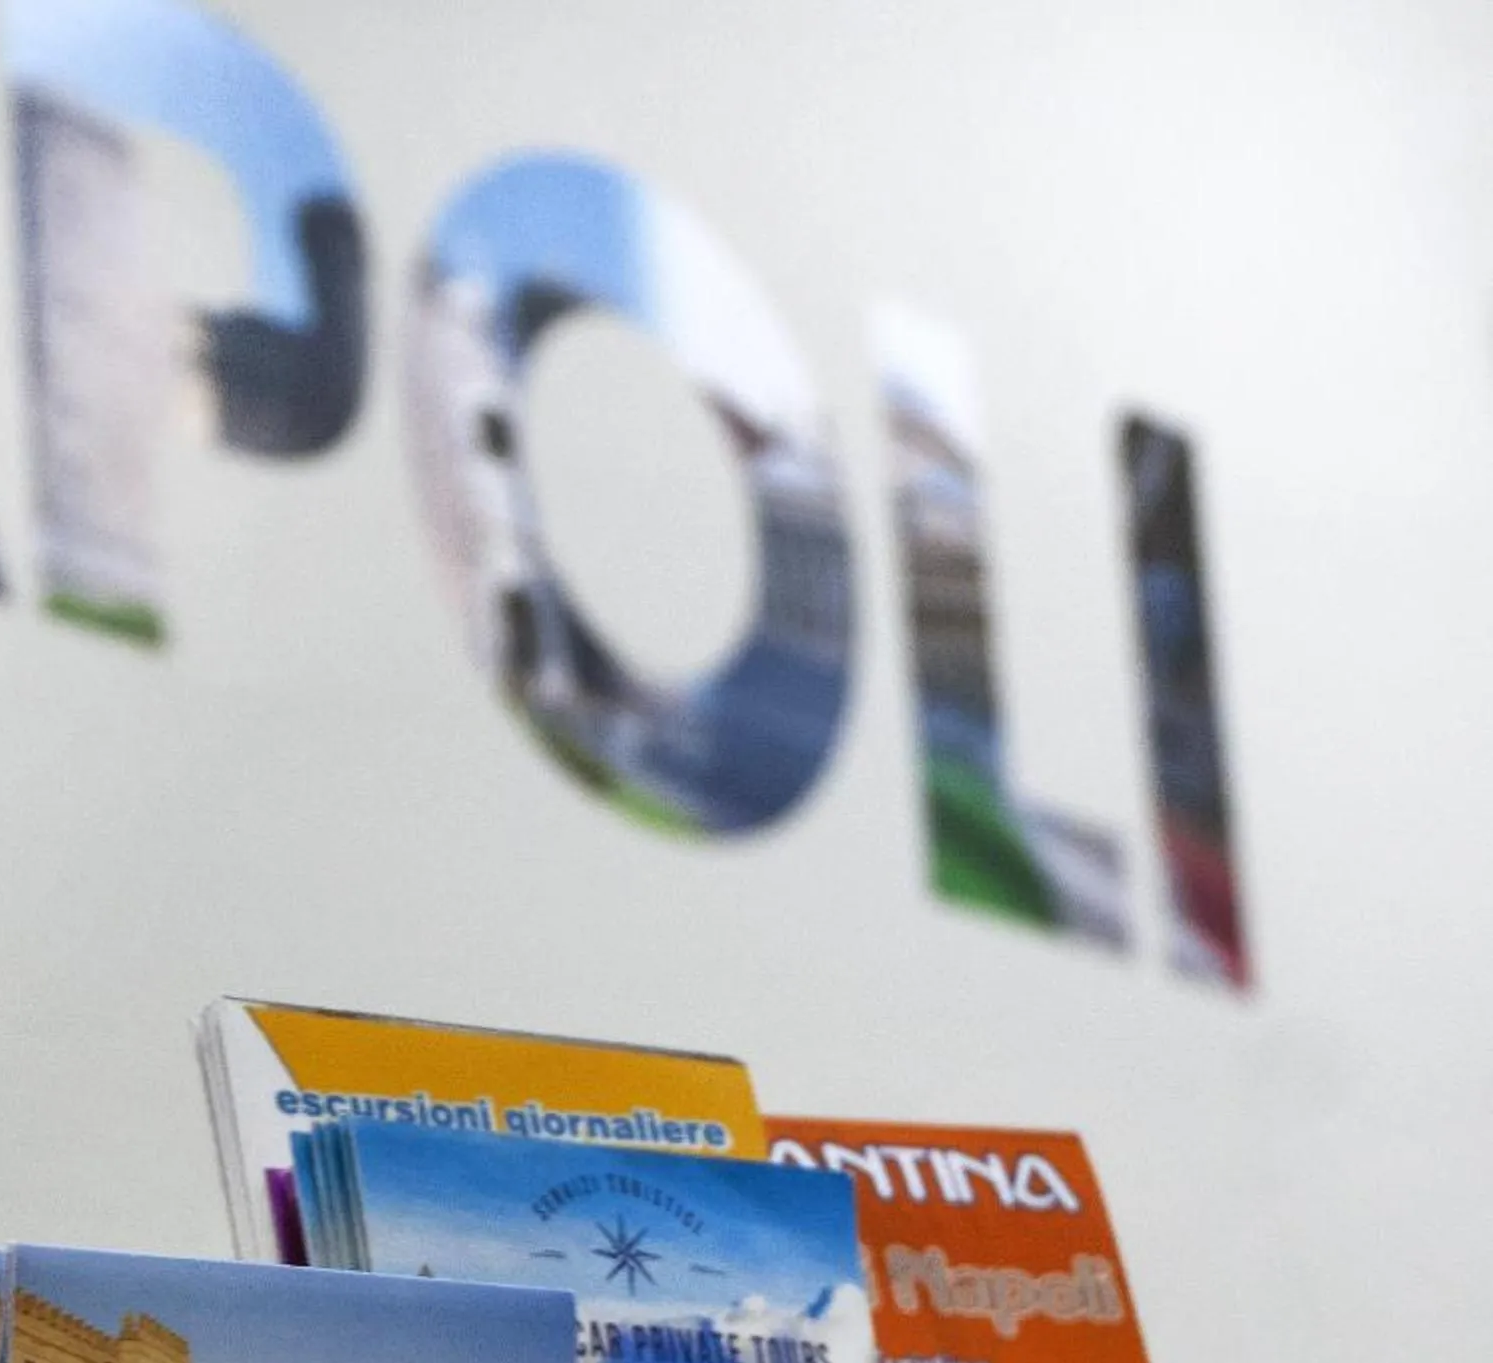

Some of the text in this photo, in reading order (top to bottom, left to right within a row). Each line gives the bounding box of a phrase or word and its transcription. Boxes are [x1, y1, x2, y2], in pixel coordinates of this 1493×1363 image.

[274, 1087, 728, 1147] escursioni giornaliere
[883, 1243, 1124, 1340] Napoli
